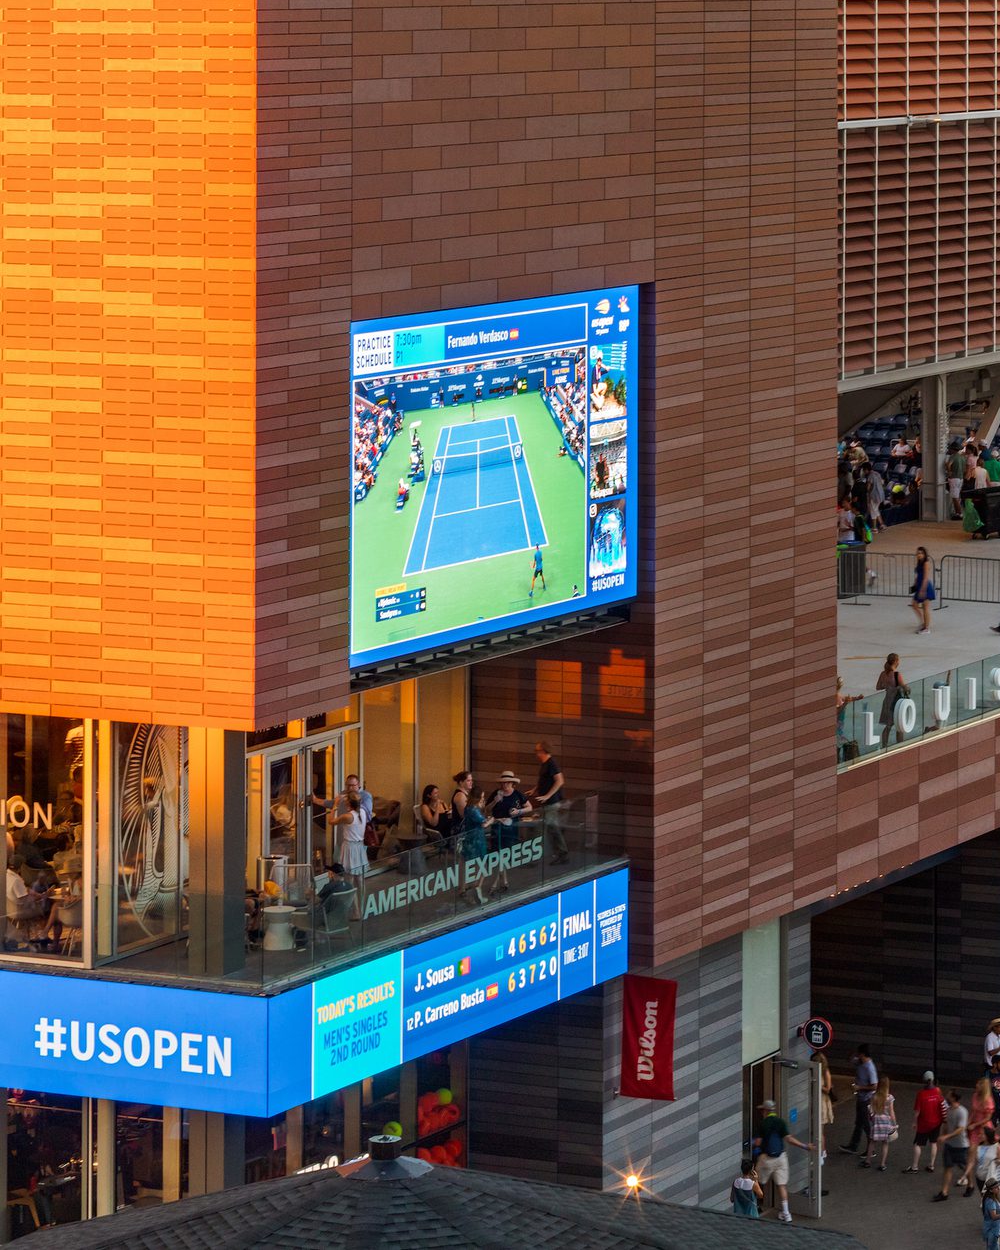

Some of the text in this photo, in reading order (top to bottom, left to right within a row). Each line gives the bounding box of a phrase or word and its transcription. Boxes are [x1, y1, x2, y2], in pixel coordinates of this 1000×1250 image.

[357, 335, 391, 352] PRACTICE
[396, 333, 422, 349] 7:30pm
[448, 329, 508, 349] Fernando Verdasco
[356, 351, 392, 368] SCHEDULE
[396, 351, 403, 364] P1
[592, 573, 625, 592] #USOPEN
[362, 836, 543, 920] AMERICAN EXPRESS
[563, 910, 592, 938] FINAL
[601, 922, 621, 947] IBM
[414, 922, 557, 992] J. Sousa 4 6 5 6 2
[317, 981, 395, 1025] TODAY'S RESULTS
[425, 1000, 459, 1024] Carreno
[460, 988, 485, 1011] Busta
[508, 972, 516, 992] 6
[518, 968, 526, 989] 3
[529, 963, 536, 984] 7
[539, 960, 546, 981] 2
[550, 956, 557, 976] 0
[324, 1010, 388, 1050] MEN'S SINGLES
[637, 1000, 658, 1081] Wilson
[34, 1017, 232, 1077] #USOPEN
[330, 1032, 380, 1066] 2ND ROUND
